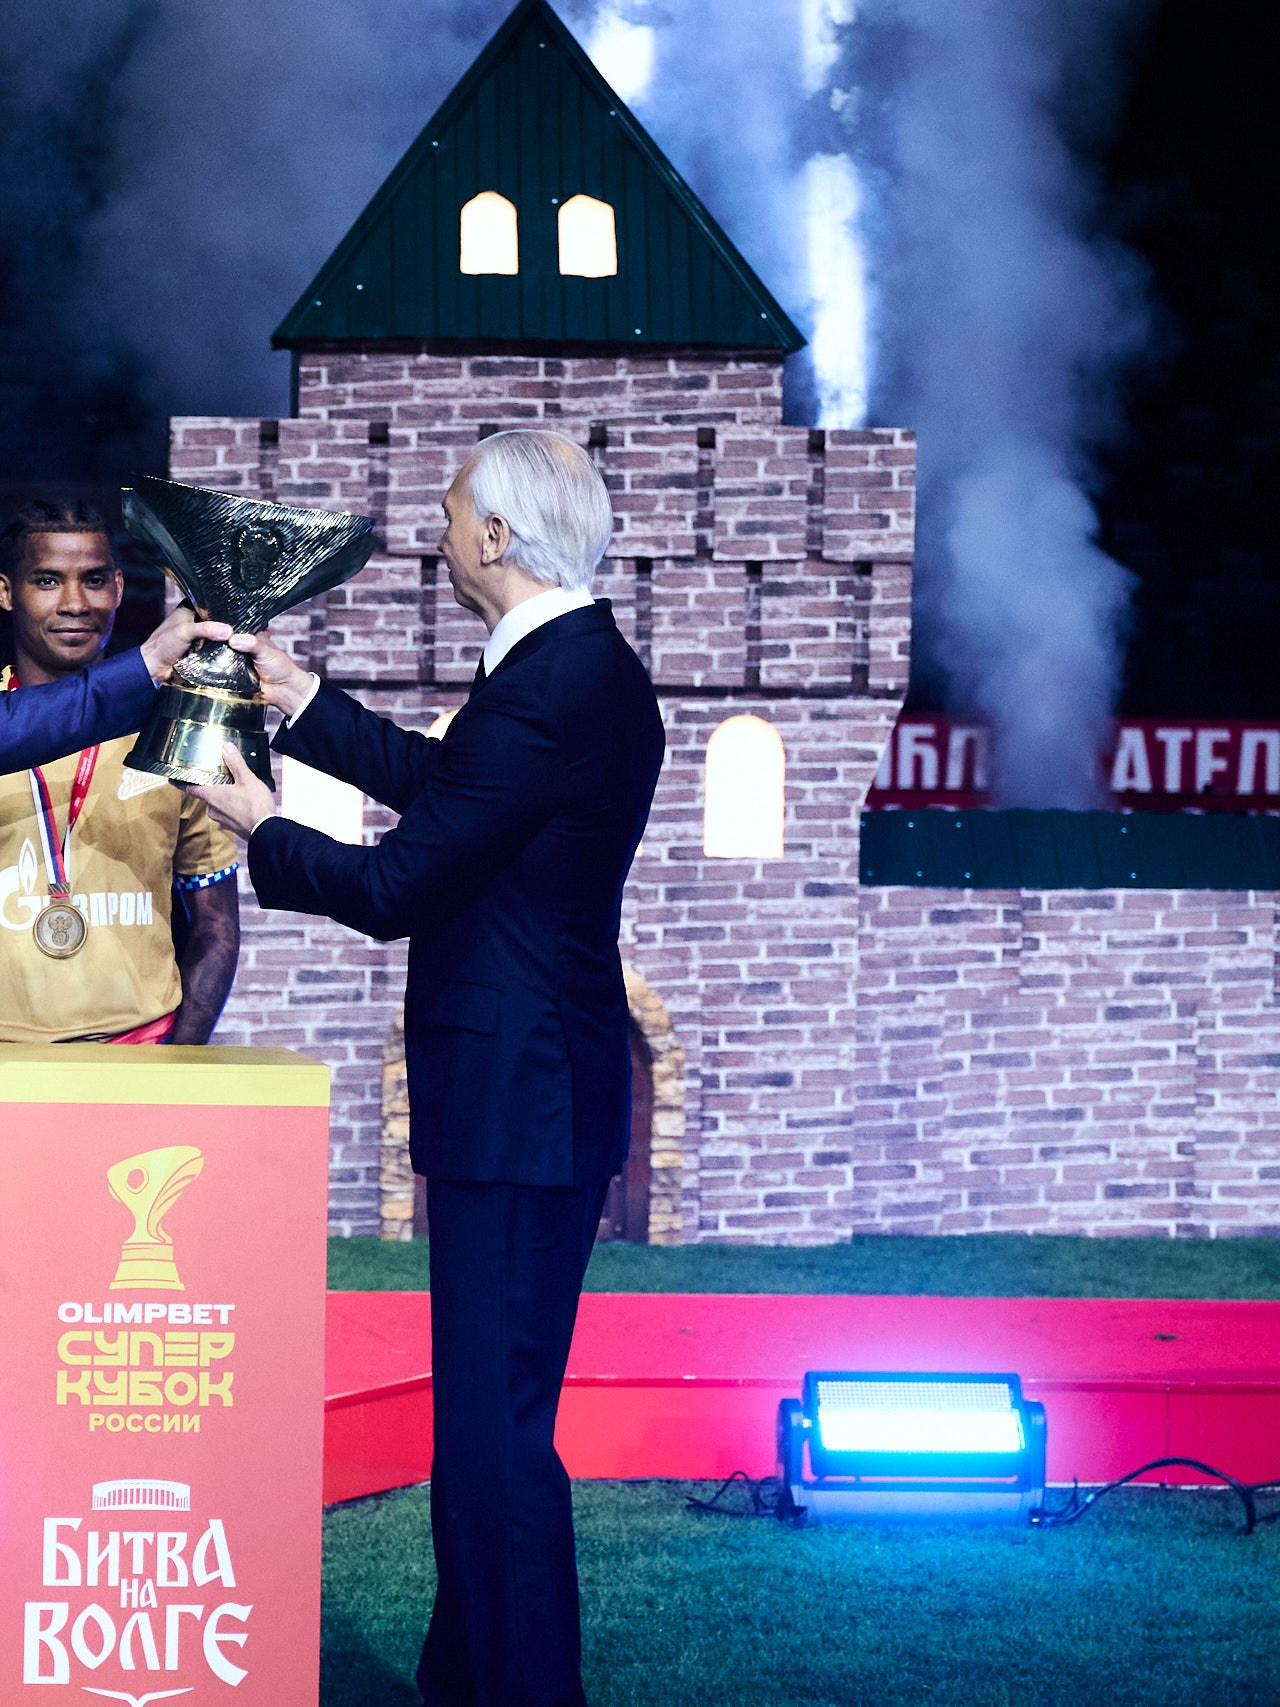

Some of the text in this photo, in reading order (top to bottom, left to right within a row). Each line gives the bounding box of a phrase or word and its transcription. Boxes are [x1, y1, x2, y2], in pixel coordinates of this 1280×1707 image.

[57, 1302, 236, 1325] OLIMPBET
[56, 1330, 236, 1367] СУПЕР
[56, 1370, 235, 1407] КУБОК
[88, 1413, 201, 1433] РОССИИ
[42, 1517, 237, 1588] БИТВА
[120, 1578, 158, 1608] НА
[23, 1601, 254, 1687] ВОЛГЕ
